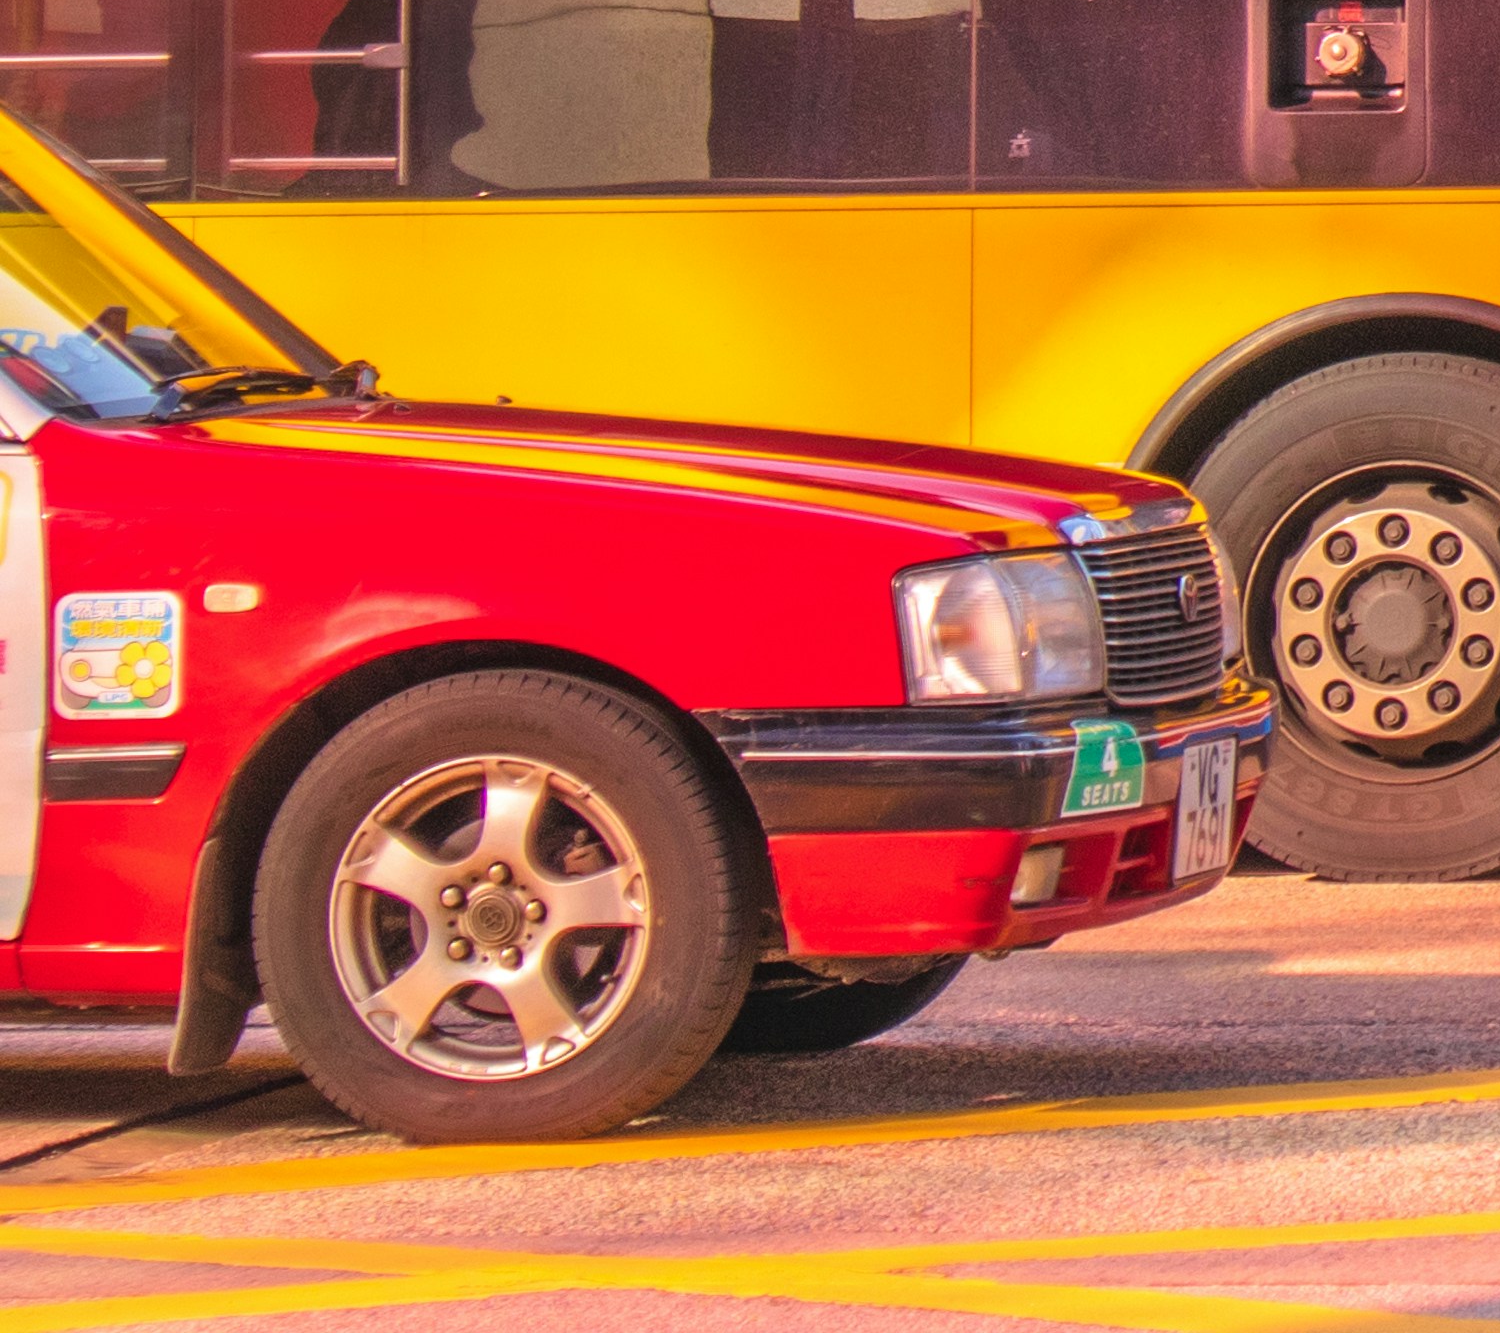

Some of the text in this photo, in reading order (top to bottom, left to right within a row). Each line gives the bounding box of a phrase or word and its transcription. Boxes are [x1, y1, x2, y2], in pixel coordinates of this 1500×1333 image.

[1101, 738, 1120, 778] 4
[1196, 745, 1220, 808] VG
[1080, 781, 1131, 807] SEATS
[1186, 804, 1226, 873] 7691
